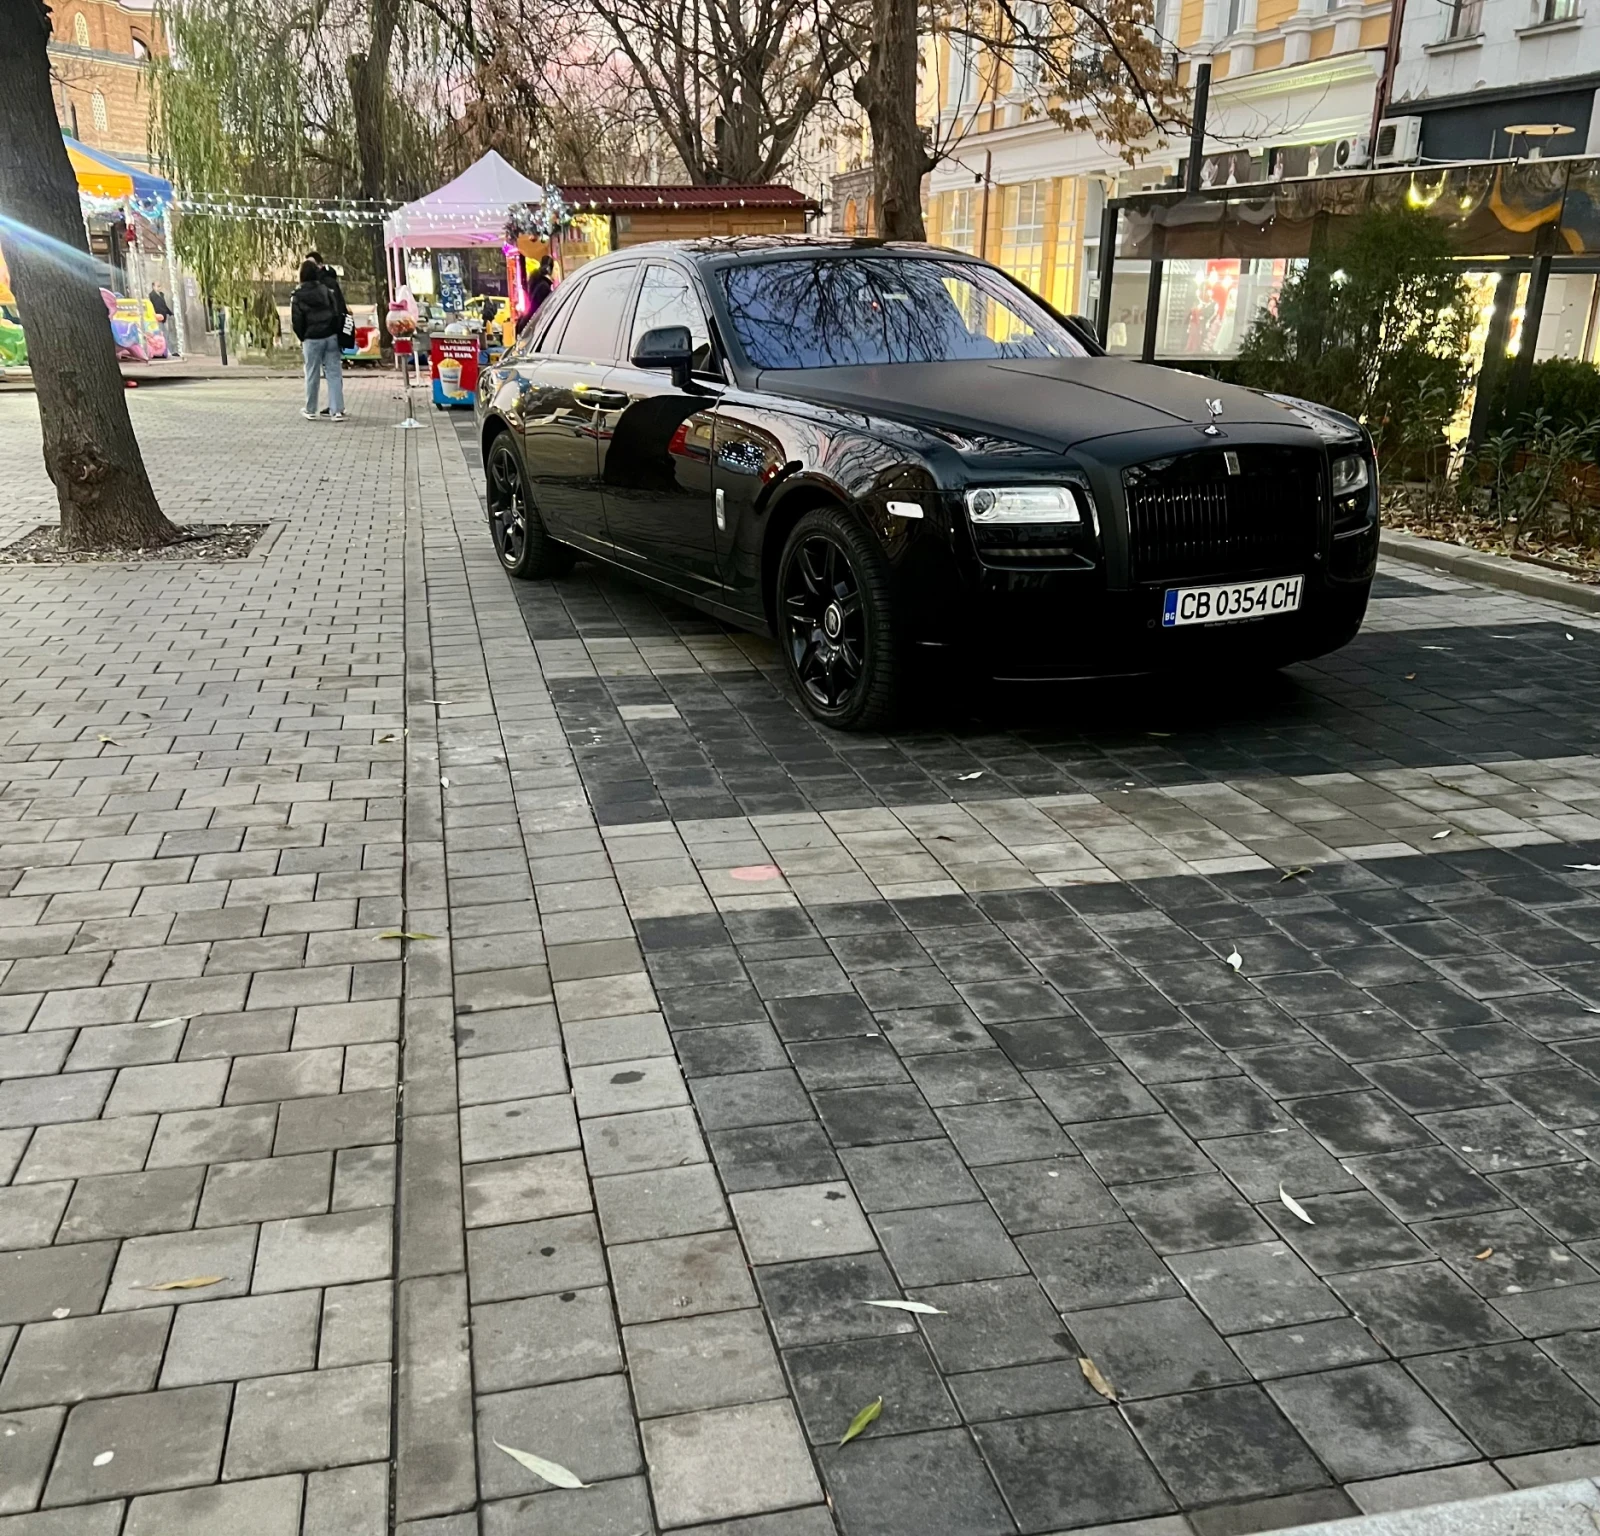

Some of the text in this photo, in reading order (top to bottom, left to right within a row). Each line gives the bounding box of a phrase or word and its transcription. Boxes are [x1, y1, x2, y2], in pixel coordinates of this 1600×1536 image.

[1180, 580, 1300, 620] CB 0354 CH
[1164, 612, 1176, 621] BG
